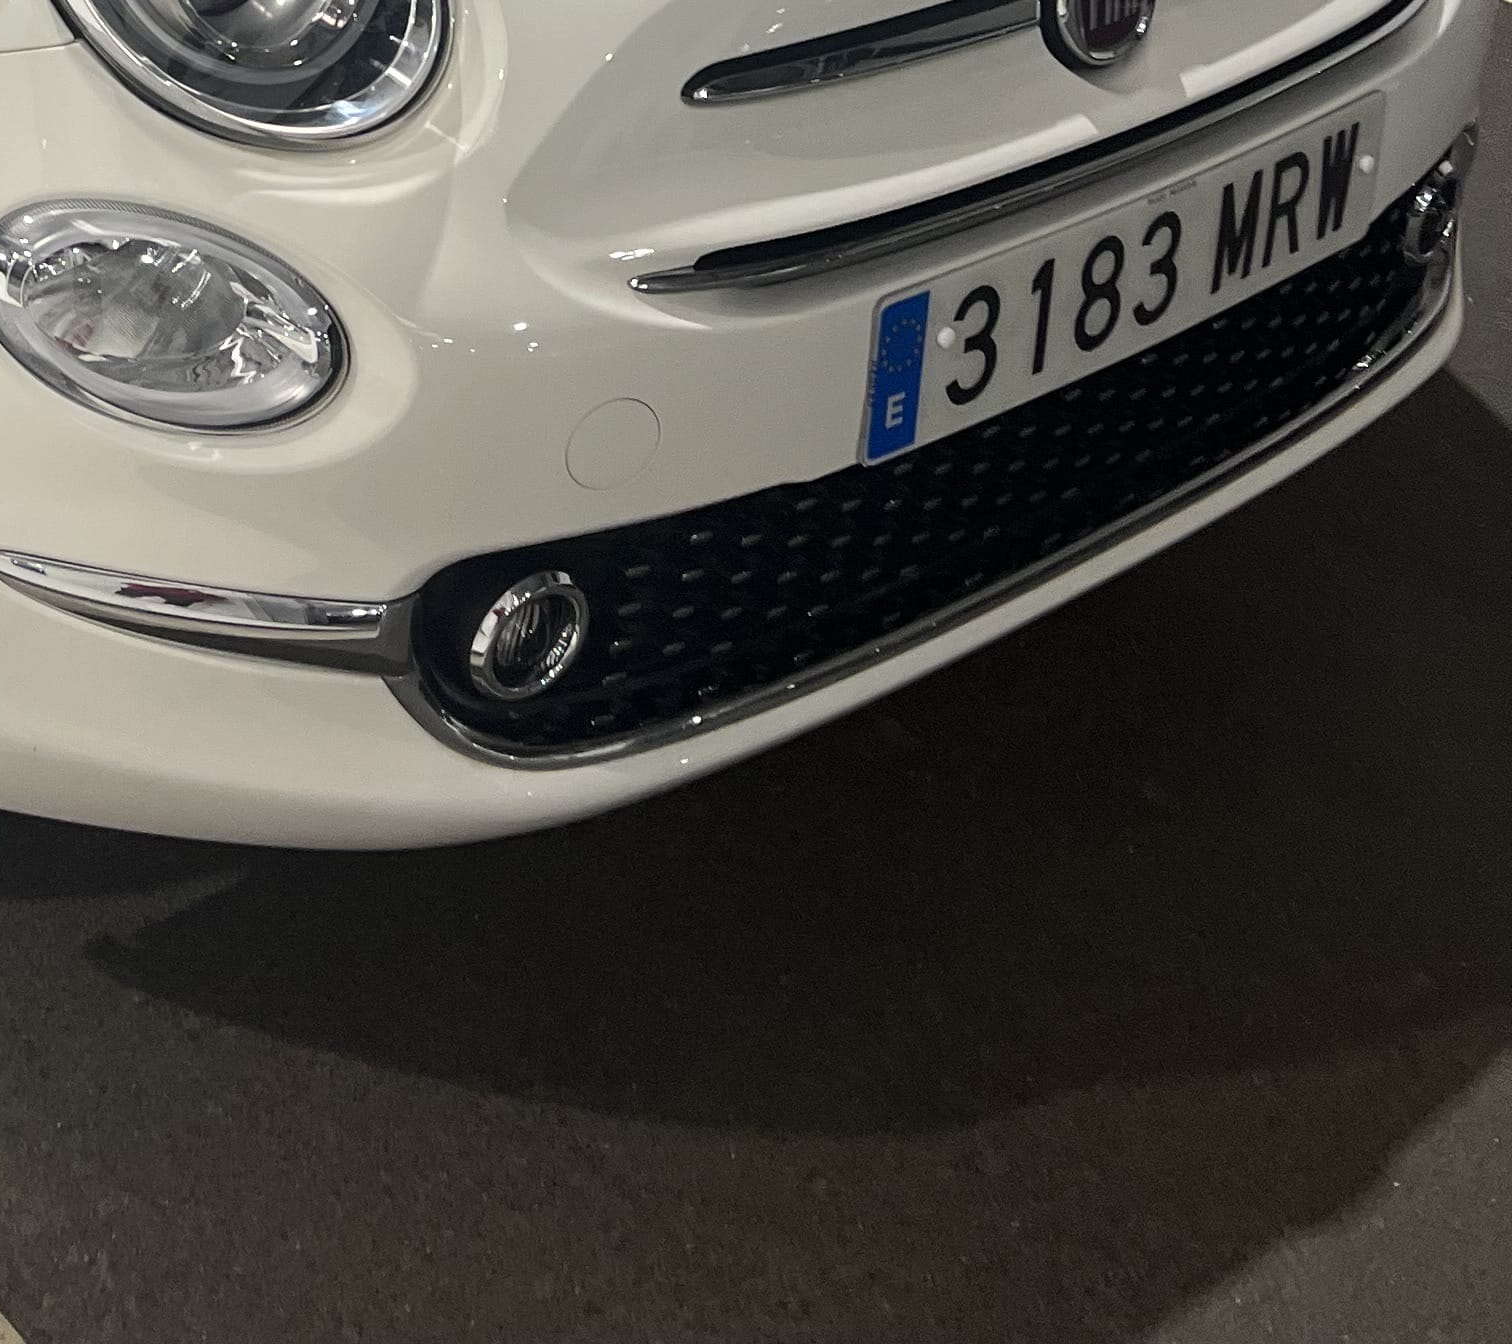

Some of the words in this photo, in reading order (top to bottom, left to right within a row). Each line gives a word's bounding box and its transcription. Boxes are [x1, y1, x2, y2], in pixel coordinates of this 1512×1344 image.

[884, 391, 906, 430] E
[946, 210, 1182, 407] 3183
[1211, 121, 1360, 295] MRW
